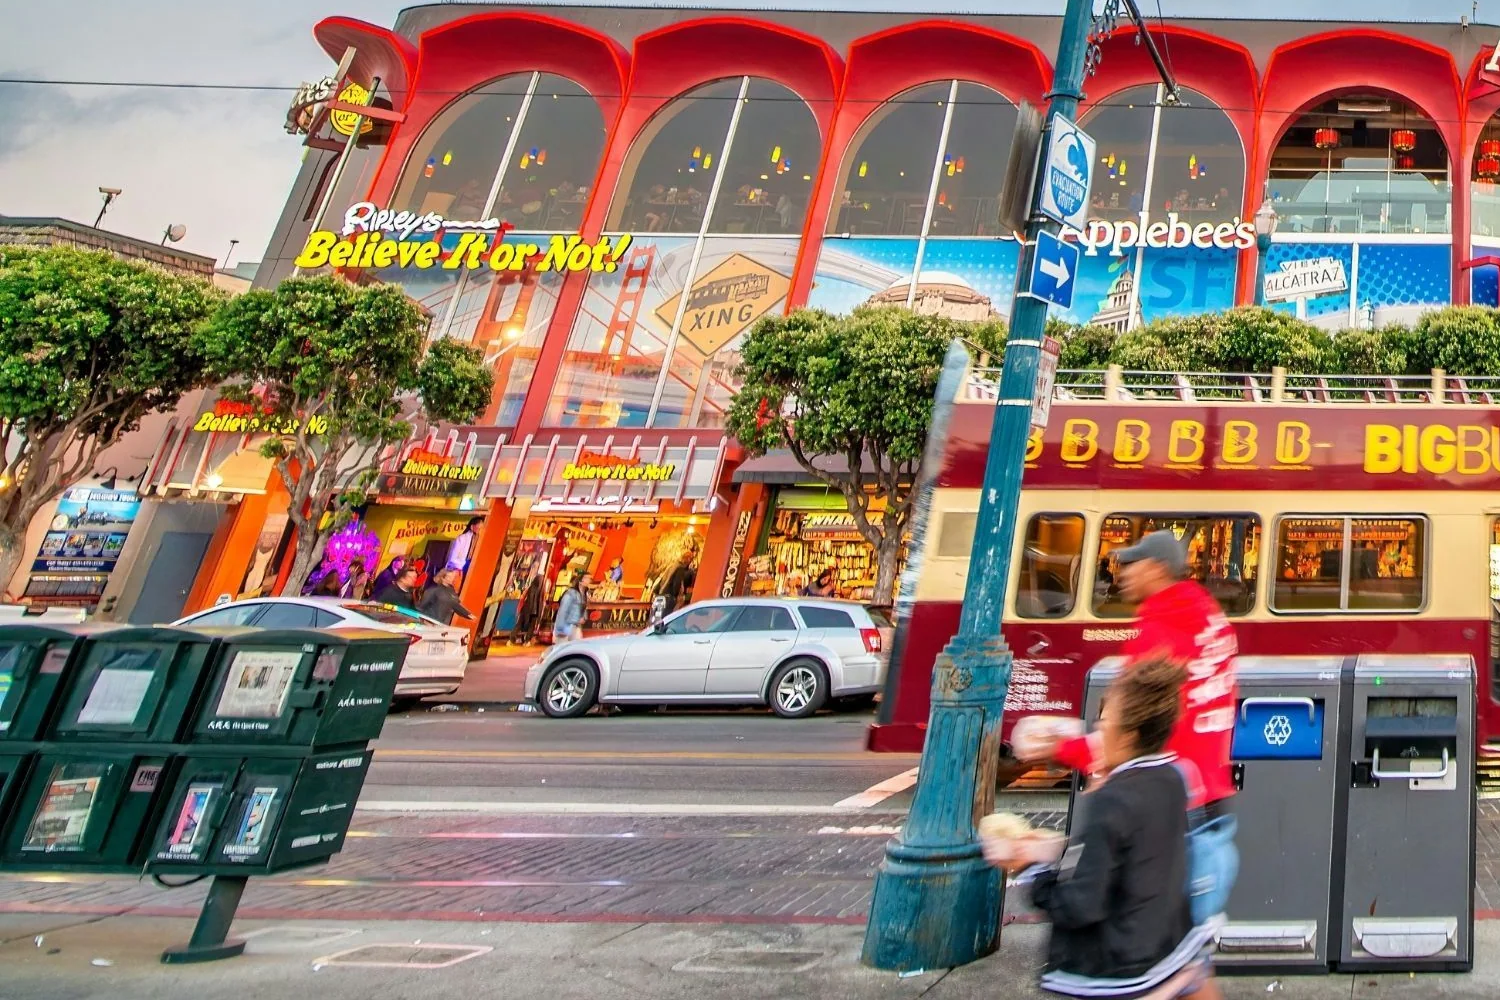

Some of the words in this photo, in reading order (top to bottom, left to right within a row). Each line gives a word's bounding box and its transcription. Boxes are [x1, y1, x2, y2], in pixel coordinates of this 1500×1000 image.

[1051, 169, 1085, 202] EVACUATION
[1057, 191, 1075, 213] ROUTE
[294, 230, 443, 269] Believe
[441, 232, 489, 270] It
[489, 244, 541, 272] or
[536, 232, 634, 274] Not!
[1151, 255, 1229, 309] SF
[689, 303, 754, 332] XING
[304, 414, 328, 435] No
[402, 459, 439, 477] Believe
[561, 463, 611, 480] Believe
[611, 464, 626, 480] It
[626, 467, 643, 480] or
[642, 464, 675, 481] Not!
